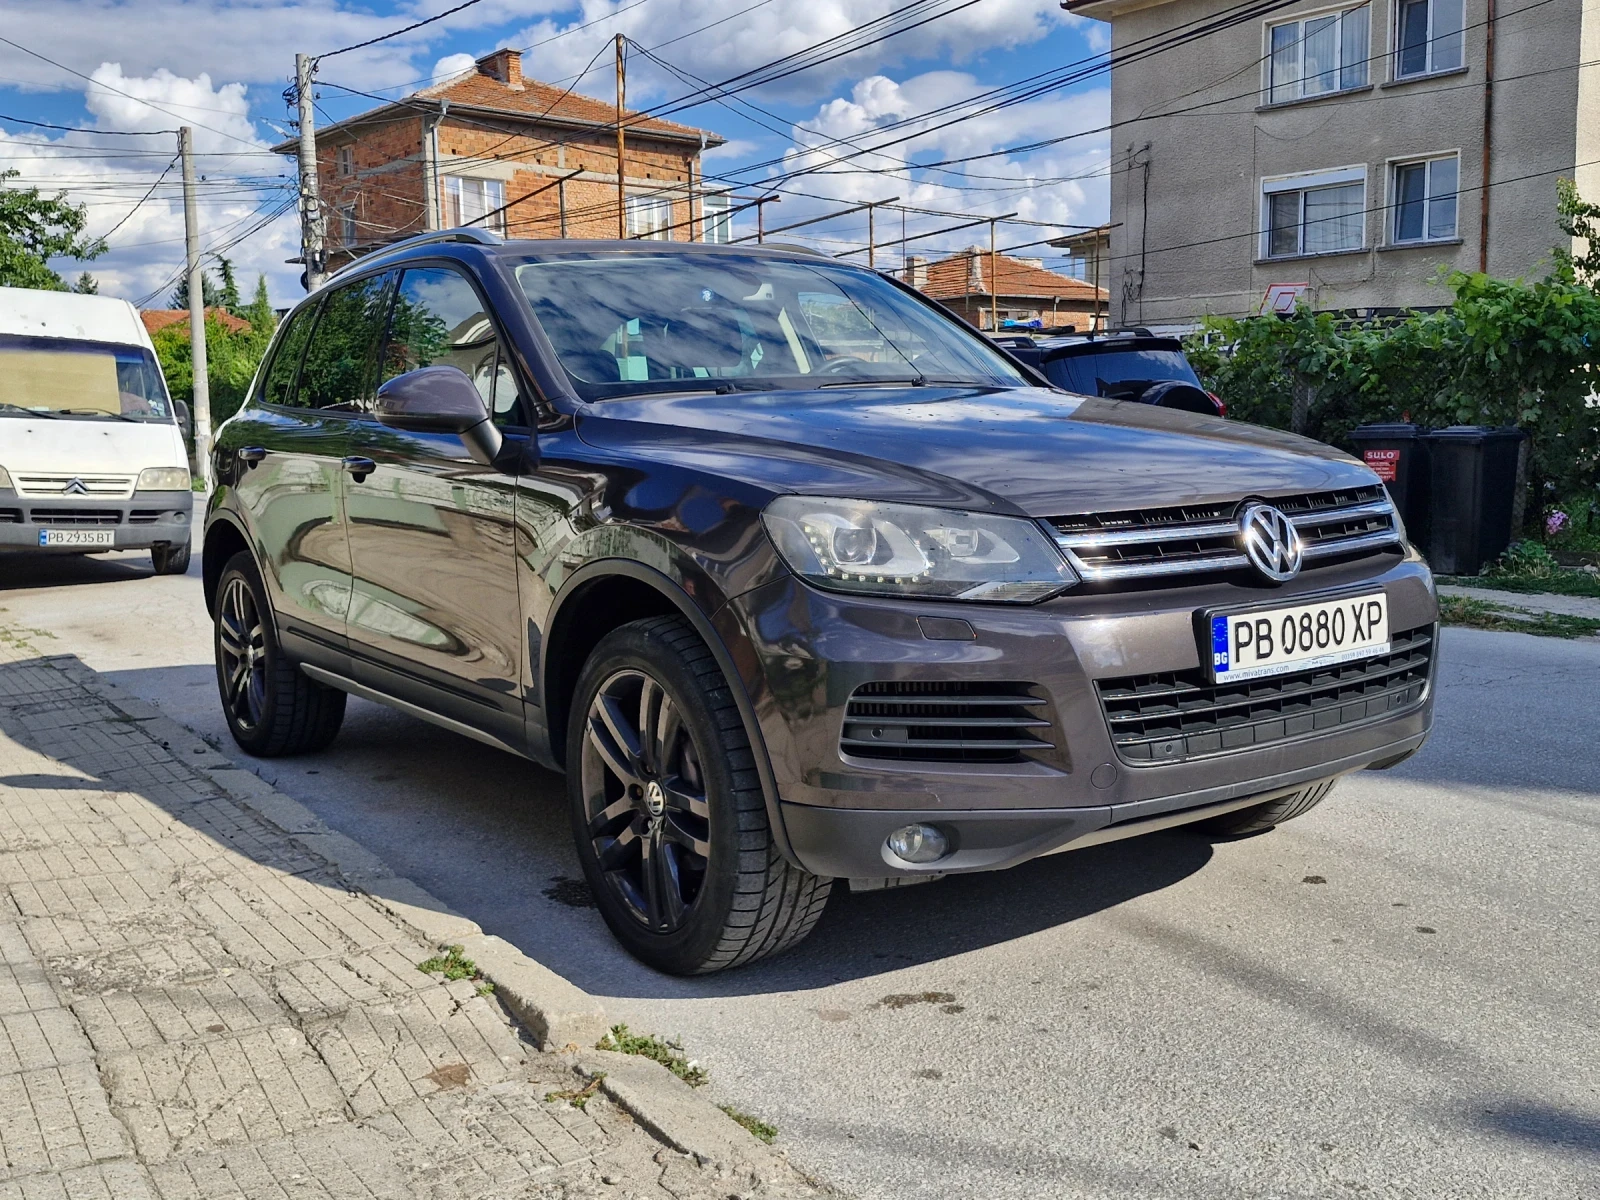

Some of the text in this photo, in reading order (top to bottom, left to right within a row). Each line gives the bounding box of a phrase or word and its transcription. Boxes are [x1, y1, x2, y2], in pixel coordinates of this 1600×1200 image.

[1367, 451, 1395, 459] SULO
[48, 532, 64, 543] PB
[66, 532, 95, 543] 2935
[96, 532, 112, 543] BT
[1244, 505, 1301, 579] VW
[1234, 600, 1382, 663] PB 0880 XP
[1213, 651, 1229, 666] BG
[1223, 664, 1290, 681] www.mivatrans.com
